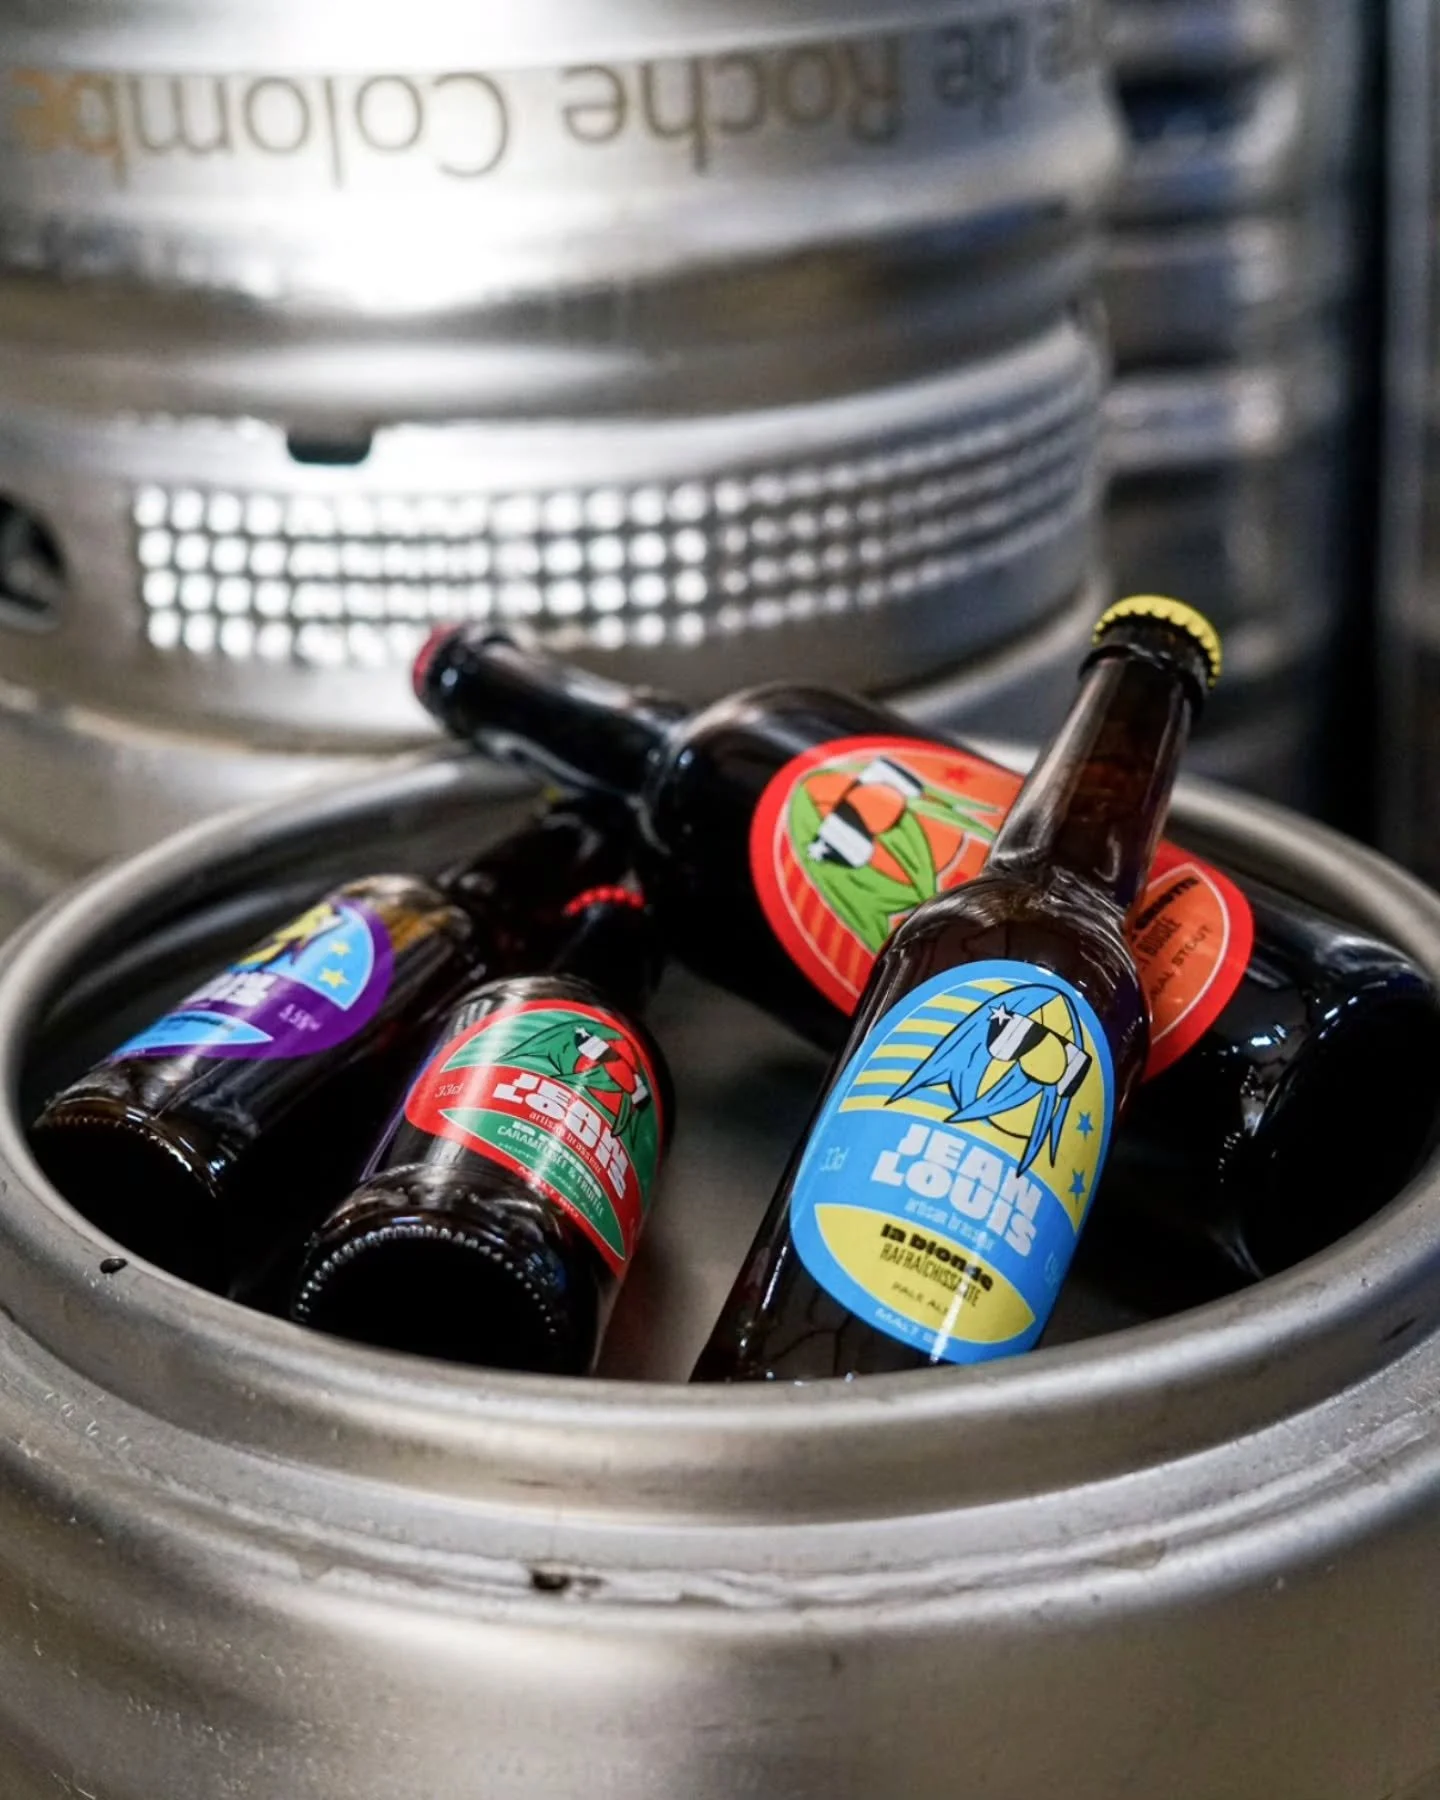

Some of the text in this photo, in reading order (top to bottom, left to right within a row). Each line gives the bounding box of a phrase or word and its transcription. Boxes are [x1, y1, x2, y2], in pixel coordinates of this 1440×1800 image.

[11, 67, 510, 190] Colombe
[559, 32, 903, 176] Roche
[493, 1084, 627, 1199] LOUIS
[513, 1073, 629, 1174] JEAN
[898, 1123, 1043, 1221] JEAN
[871, 1150, 1037, 1257] LOUIS
[879, 1222, 907, 1245] la
[908, 1233, 994, 1292] blonde
[891, 1281, 924, 1305] PALE
